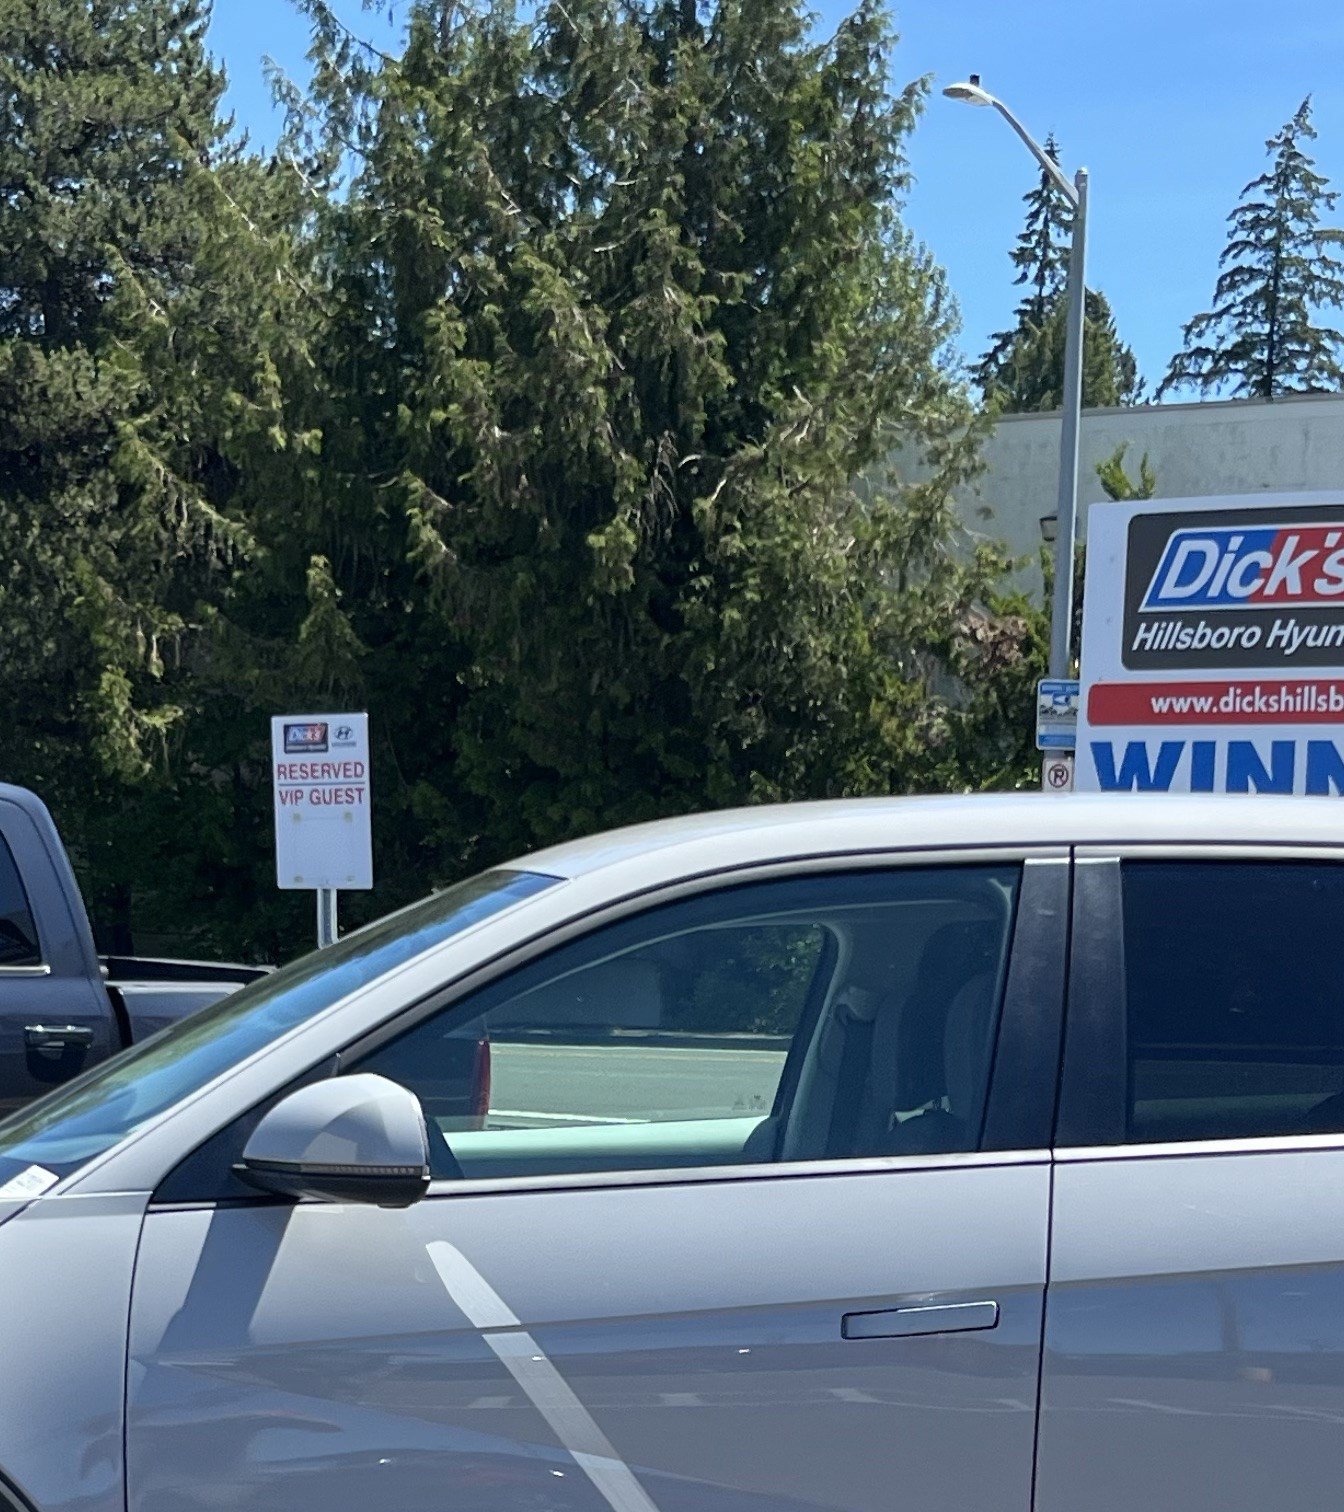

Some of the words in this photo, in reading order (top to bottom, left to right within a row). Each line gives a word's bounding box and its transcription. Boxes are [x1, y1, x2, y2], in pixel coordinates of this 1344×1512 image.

[1132, 619, 1262, 651] Hillsboro
[277, 761, 365, 780] RESERVED
[279, 788, 304, 806] VIP
[309, 787, 365, 806] GUEST
